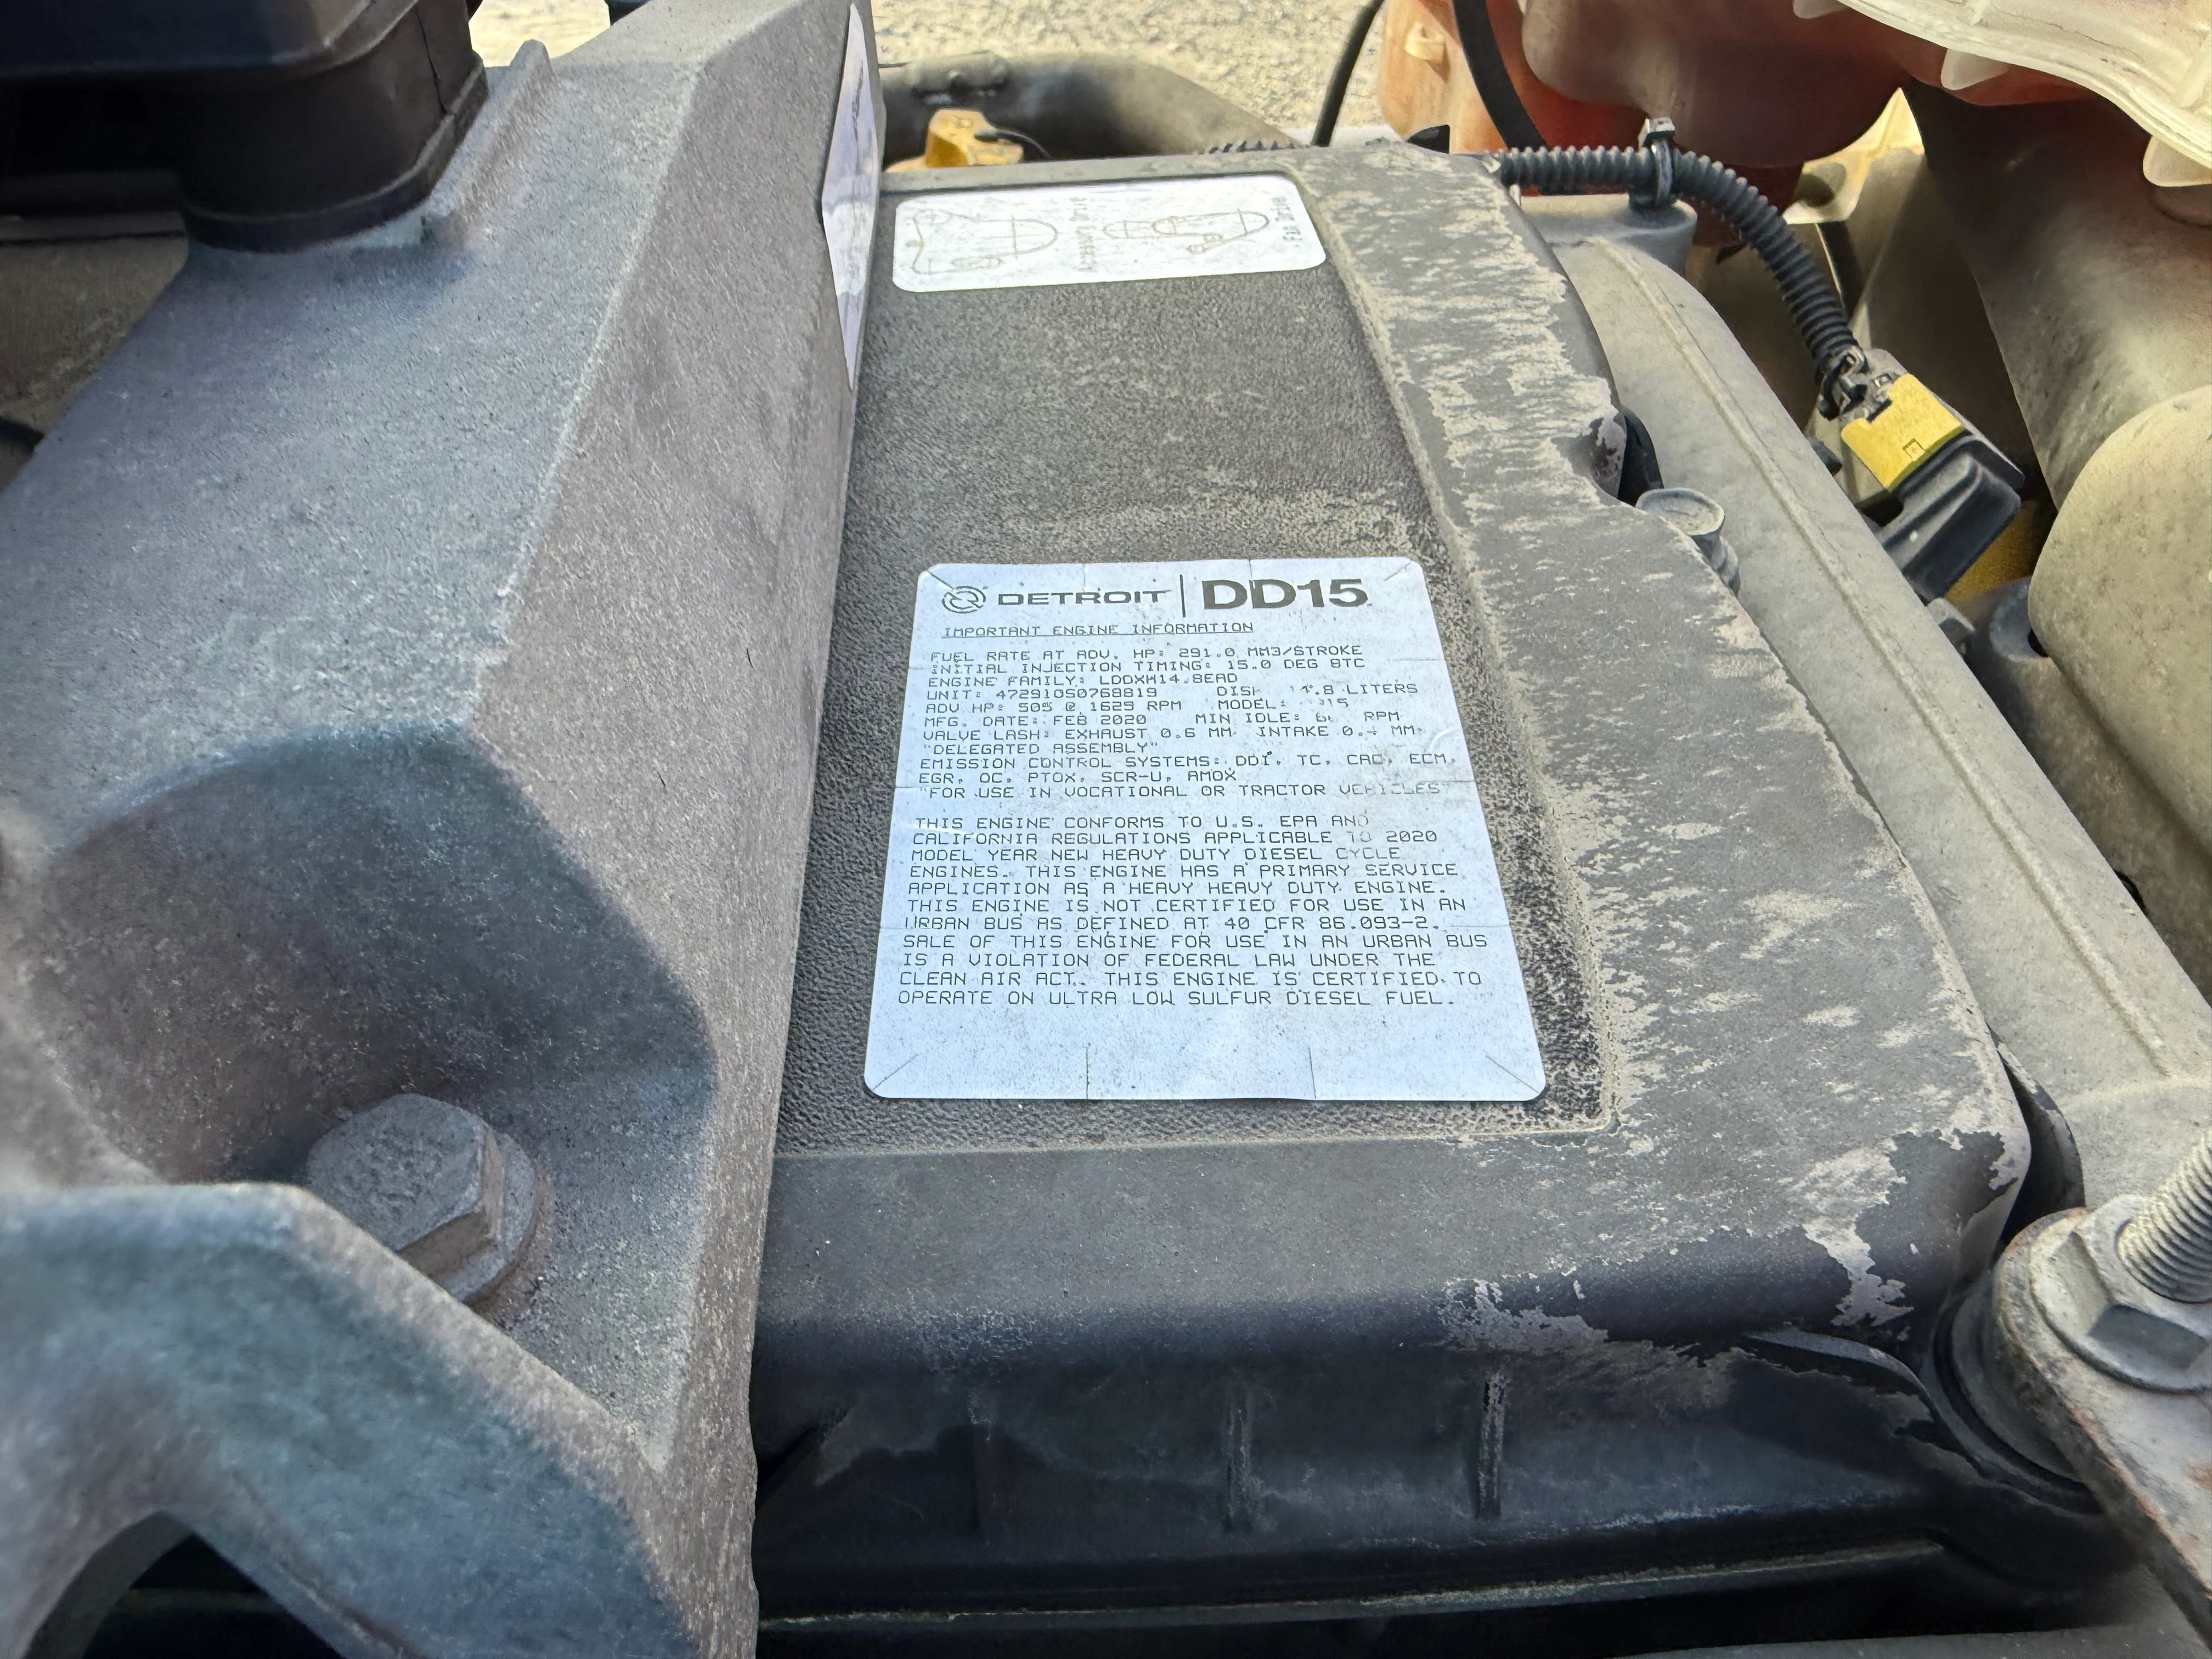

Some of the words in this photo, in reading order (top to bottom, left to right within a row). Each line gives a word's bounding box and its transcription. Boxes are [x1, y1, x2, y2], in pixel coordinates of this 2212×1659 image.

[998, 590, 1171, 605] DETROIT
[1202, 579, 1368, 610] DD15
[944, 626, 1040, 636] IMPORTANT
[1053, 625, 1119, 635] ENGINE
[1133, 623, 1253, 634] INFORMATION
[931, 652, 974, 663] FUEL
[987, 651, 1030, 661] RATE
[1043, 650, 1064, 659] AT
[1077, 650, 1118, 659] ADV.
[1133, 649, 1163, 658] HP:
[1179, 648, 1235, 657] 291.0
[1248, 645, 1362, 657] MM3/STROKE
[932, 664, 1007, 674] INITIAL
[1023, 662, 1121, 673] INJECTION
[1135, 661, 1210, 671] TIMING:
[1228, 660, 1271, 669] 15.0
[1284, 659, 1318, 669] DEG
[1330, 658, 1364, 668] BTC
[929, 677, 997, 687] ENGINE
[1008, 676, 1084, 686] FAMILY:
[927, 690, 980, 699] UNIT:
[1347, 684, 1418, 694] LITERS
[926, 704, 959, 713] ADV
[972, 703, 1003, 713] HP:
[1019, 702, 1052, 712] 505
[1065, 702, 1075, 711] @
[1147, 701, 1181, 710] RPM
[1218, 698, 1285, 709] MODEL:
[924, 717, 967, 727] MFG.
[983, 716, 1037, 726] DATE:
[1054, 715, 1087, 725] FEB
[1101, 715, 1146, 725] 2020
[1195, 714, 1230, 724] MIN
[1246, 713, 1299, 723] IDLE:
[1363, 712, 1400, 721] RPM
[923, 730, 980, 741] VALVE
[994, 730, 1048, 740] LASH:
[1065, 729, 1147, 739] EXHAUST
[1161, 728, 1195, 738] 0.6
[1257, 726, 1329, 737] INTAKE
[921, 758, 1015, 769] EMISSION
[1029, 758, 1111, 768] CONTROL
[1126, 756, 1219, 767] SYSTEMS:
[1188, 770, 1236, 781] AMOX
[979, 787, 1014, 798] USE
[1030, 787, 1051, 798] IN
[1065, 786, 1187, 798] VOCATIONAL
[1201, 786, 1224, 796] OR
[1239, 785, 1325, 797] TRACTOR
[916, 818, 963, 829] THIS
[977, 817, 1050, 829] ENGINE
[1065, 816, 1164, 828] CONFORMS
[1178, 816, 1201, 828] TO
[1216, 816, 1263, 827] U.S.
[1280, 815, 1317, 827] EPA
[1331, 815, 1369, 826] AND
[913, 833, 1037, 845] CALIFORNIA
[1052, 832, 1190, 844] REGULATIONS
[1205, 831, 1332, 844] APPLICABLE
[1347, 831, 1372, 843] TO
[1386, 831, 1437, 842] 2020
[912, 849, 973, 861] MODEL
[988, 849, 1037, 861] YEAR
[1052, 849, 1088, 861] NEW
[1103, 849, 1166, 861] HEAVY
[1180, 848, 1230, 860] DUTY
[1245, 848, 1322, 860] DIESEL
[1336, 847, 1400, 859] CYCLE
[911, 865, 1008, 878] ENGINES.
[1025, 865, 1075, 877] THIS
[1090, 865, 1166, 877] ENGINE
[1181, 865, 1218, 877] HAS
[1234, 865, 1245, 877] A
[1260, 865, 1350, 878] PRIMARY
[1365, 862, 1458, 876] SERVICE
[909, 883, 1049, 895] APPLICATION
[1064, 883, 1088, 894] AS
[1103, 882, 1114, 894] A
[1130, 882, 1193, 894] HEAVY
[1209, 882, 1272, 895] HEAVY
[1288, 882, 1341, 894] DUTY
[1355, 881, 1445, 894] ENGINE.
[908, 900, 957, 912] THIS
[972, 899, 1049, 912] ENGINE
[1066, 900, 1088, 912] IS
[1104, 899, 1141, 912] NOT
[1156, 899, 1275, 912] CERTIFIED
[1290, 899, 1329, 912] FOR
[1344, 899, 1384, 911] USE
[1400, 898, 1424, 911] IN
[1439, 898, 1465, 911] AN
[905, 916, 969, 929] URBAN
[985, 917, 1022, 929] BUS
[1037, 917, 1062, 930] AS
[1077, 916, 1169, 932] DEFINED
[1184, 917, 1209, 929] AT
[1224, 917, 1249, 929] 40
[1265, 917, 1304, 929] CFR
[1319, 916, 1438, 929] 86.093-2.
[904, 935, 955, 948] SALE
[970, 935, 995, 948] OF
[1011, 935, 1062, 948] THIS
[1077, 933, 1156, 948] ENGINE
[1172, 935, 1211, 948] FOR
[1226, 935, 1266, 949] USE
[1283, 935, 1306, 948] IN
[1322, 935, 1348, 948] AN
[1363, 934, 1431, 947] URBAN
[1446, 934, 1487, 947] BUS
[904, 953, 927, 966] IS
[942, 953, 953, 966] A
[969, 953, 1088, 967] VIOLATION
[1104, 953, 1129, 967] OF
[1146, 953, 1239, 967] FEDERAL
[1255, 953, 1295, 967] LAW
[1310, 953, 1379, 966] UNDER
[1393, 953, 1435, 966] THE
[900, 972, 966, 985] CLEAN
[981, 972, 1020, 986] AIR
[1036, 972, 1076, 986] ACT.
[1104, 972, 1159, 986] THIS
[1174, 972, 1255, 986] ENGINE
[1273, 971, 1297, 986] IS
[1453, 972, 1481, 985] TO
[899, 991, 992, 1005] OPERATE
[1008, 991, 1033, 1005] ON
[1049, 991, 1116, 1005] ULTRA
[1133, 990, 1175, 1006] LOW
[1188, 991, 1271, 1005] SULFUR
[1286, 991, 1371, 1005] DIESEL
[1386, 991, 1453, 1005] FUEL.
